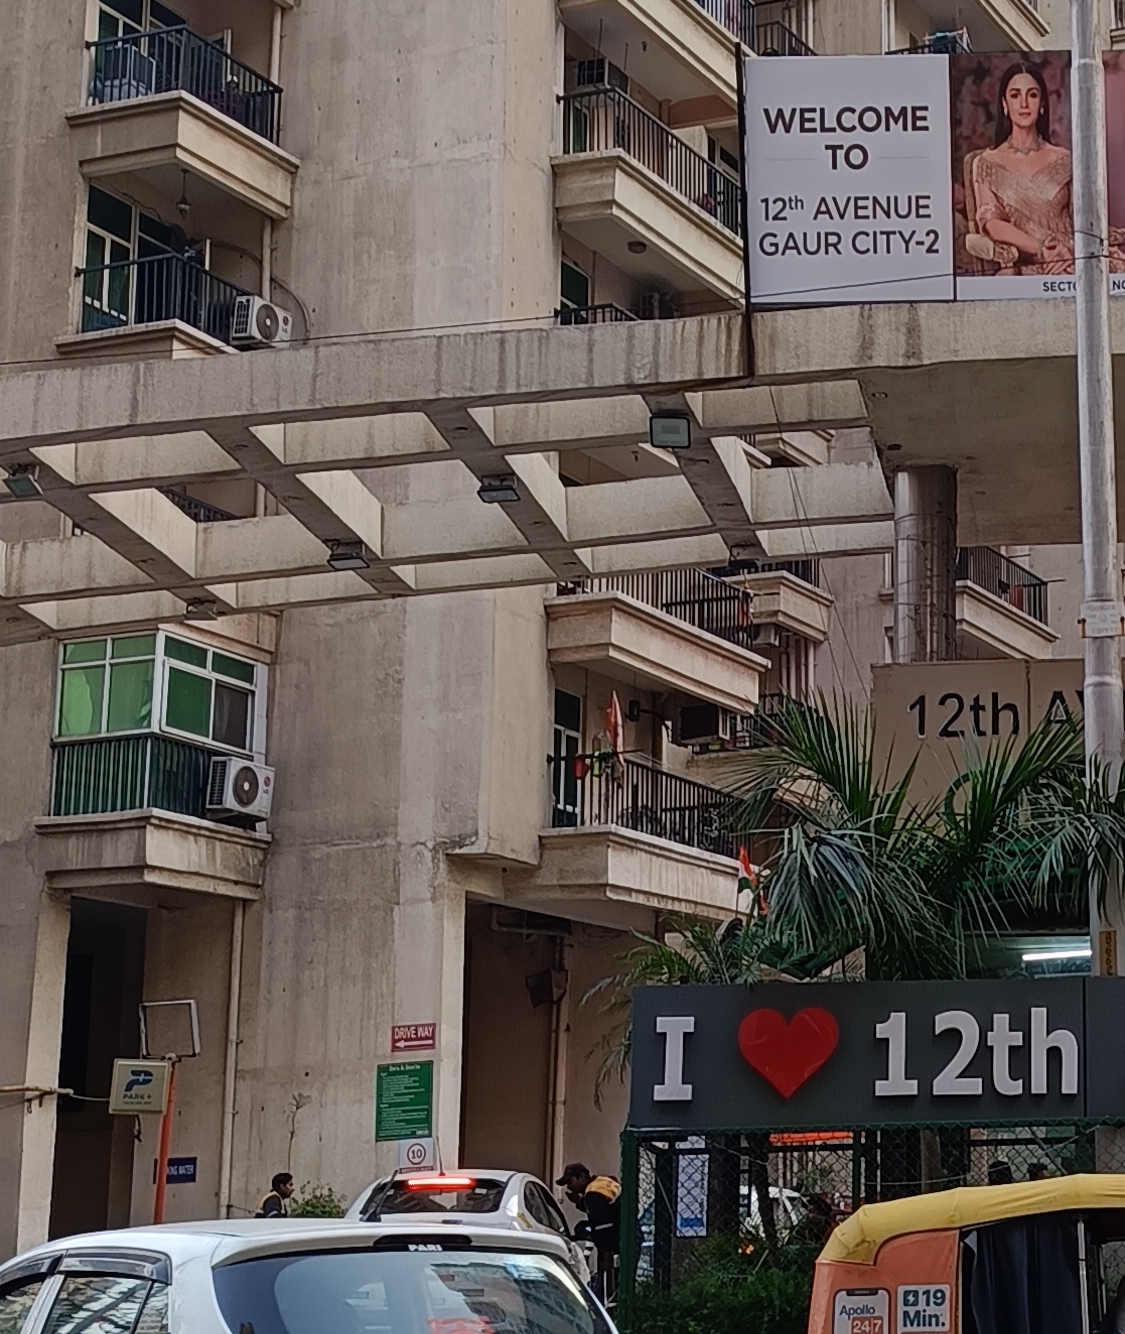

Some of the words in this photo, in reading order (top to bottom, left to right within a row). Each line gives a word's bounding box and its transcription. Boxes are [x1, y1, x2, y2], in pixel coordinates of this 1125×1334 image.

[762, 105, 930, 134] WELCOME
[824, 143, 869, 170] TO
[759, 195, 804, 221] 12th
[812, 195, 932, 220] AVENUE
[758, 231, 842, 257] GAUR
[851, 229, 940, 255] CITY-2
[907, 691, 1020, 740] 12th
[394, 1026, 417, 1040] DRIVE
[417, 1025, 434, 1039] WAY
[653, 1016, 696, 1102] I
[874, 1007, 1080, 1097] 12th
[411, 1148, 423, 1160] 10
[408, 1244, 443, 1252] PARI
[922, 1288, 947, 1307] 19
[839, 1304, 876, 1321] Apollo
[902, 1308, 946, 1328] Min.
